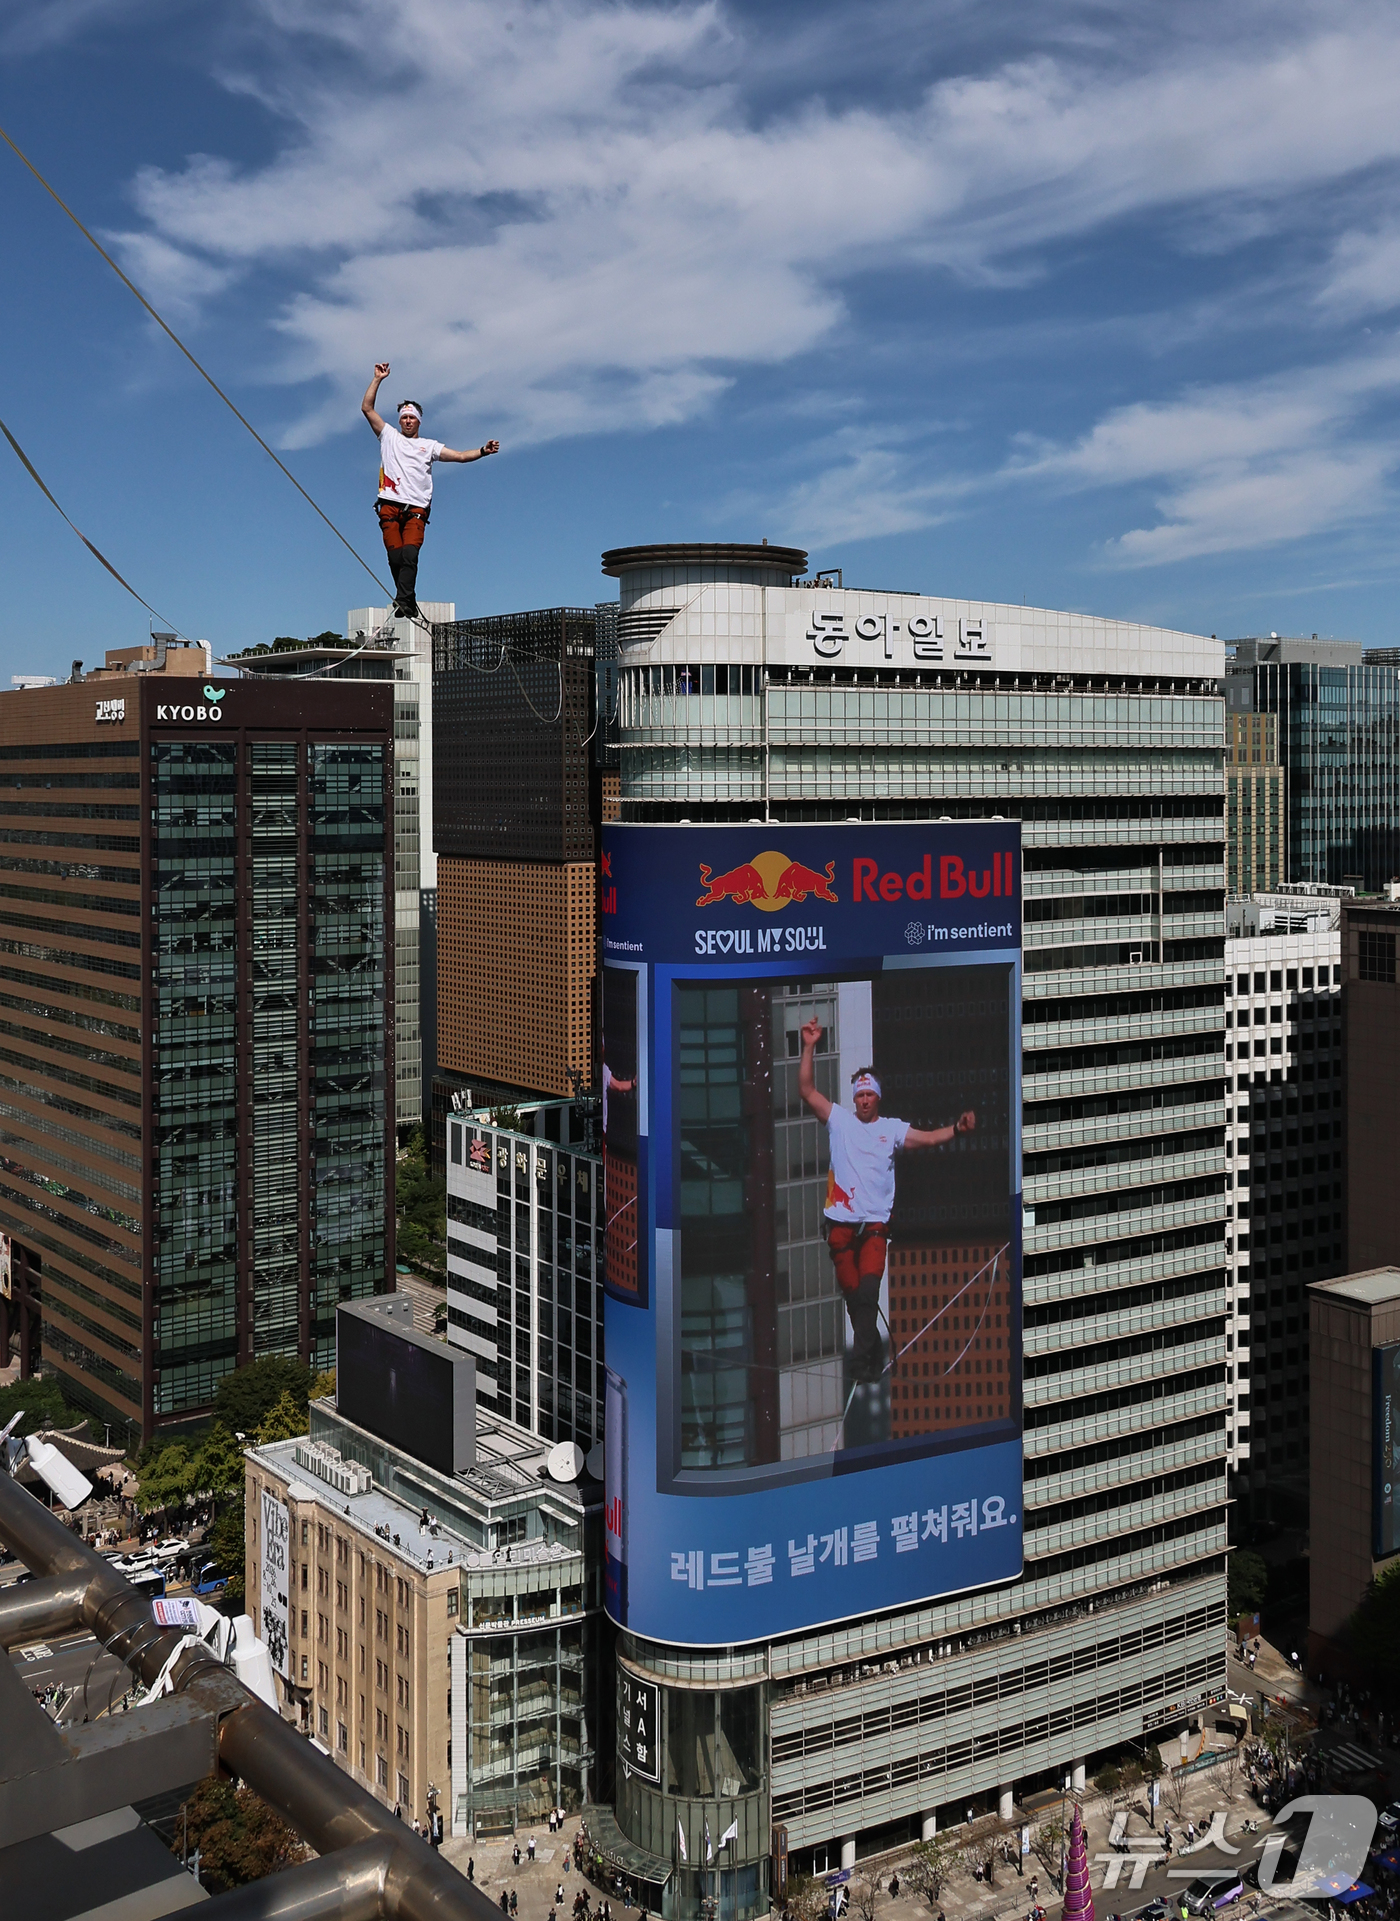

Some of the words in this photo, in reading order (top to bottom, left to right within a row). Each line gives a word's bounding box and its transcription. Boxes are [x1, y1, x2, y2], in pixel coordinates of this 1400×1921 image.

[806, 610, 993, 661] 동아일보
[157, 705, 222, 721] KYOBO
[853, 854, 932, 902] Red
[940, 852, 1013, 899] Bull
[950, 922, 1013, 940] sentient
[263, 1494, 288, 1542] Vibe
[604, 1496, 622, 1538] ull
[266, 1528, 285, 1571] Era
[671, 1542, 776, 1590] 레드불
[787, 1520, 880, 1577] 날개를
[890, 1496, 1017, 1554] 펼쳐줘요.
[511, 1615, 545, 1627] PRESSEUM
